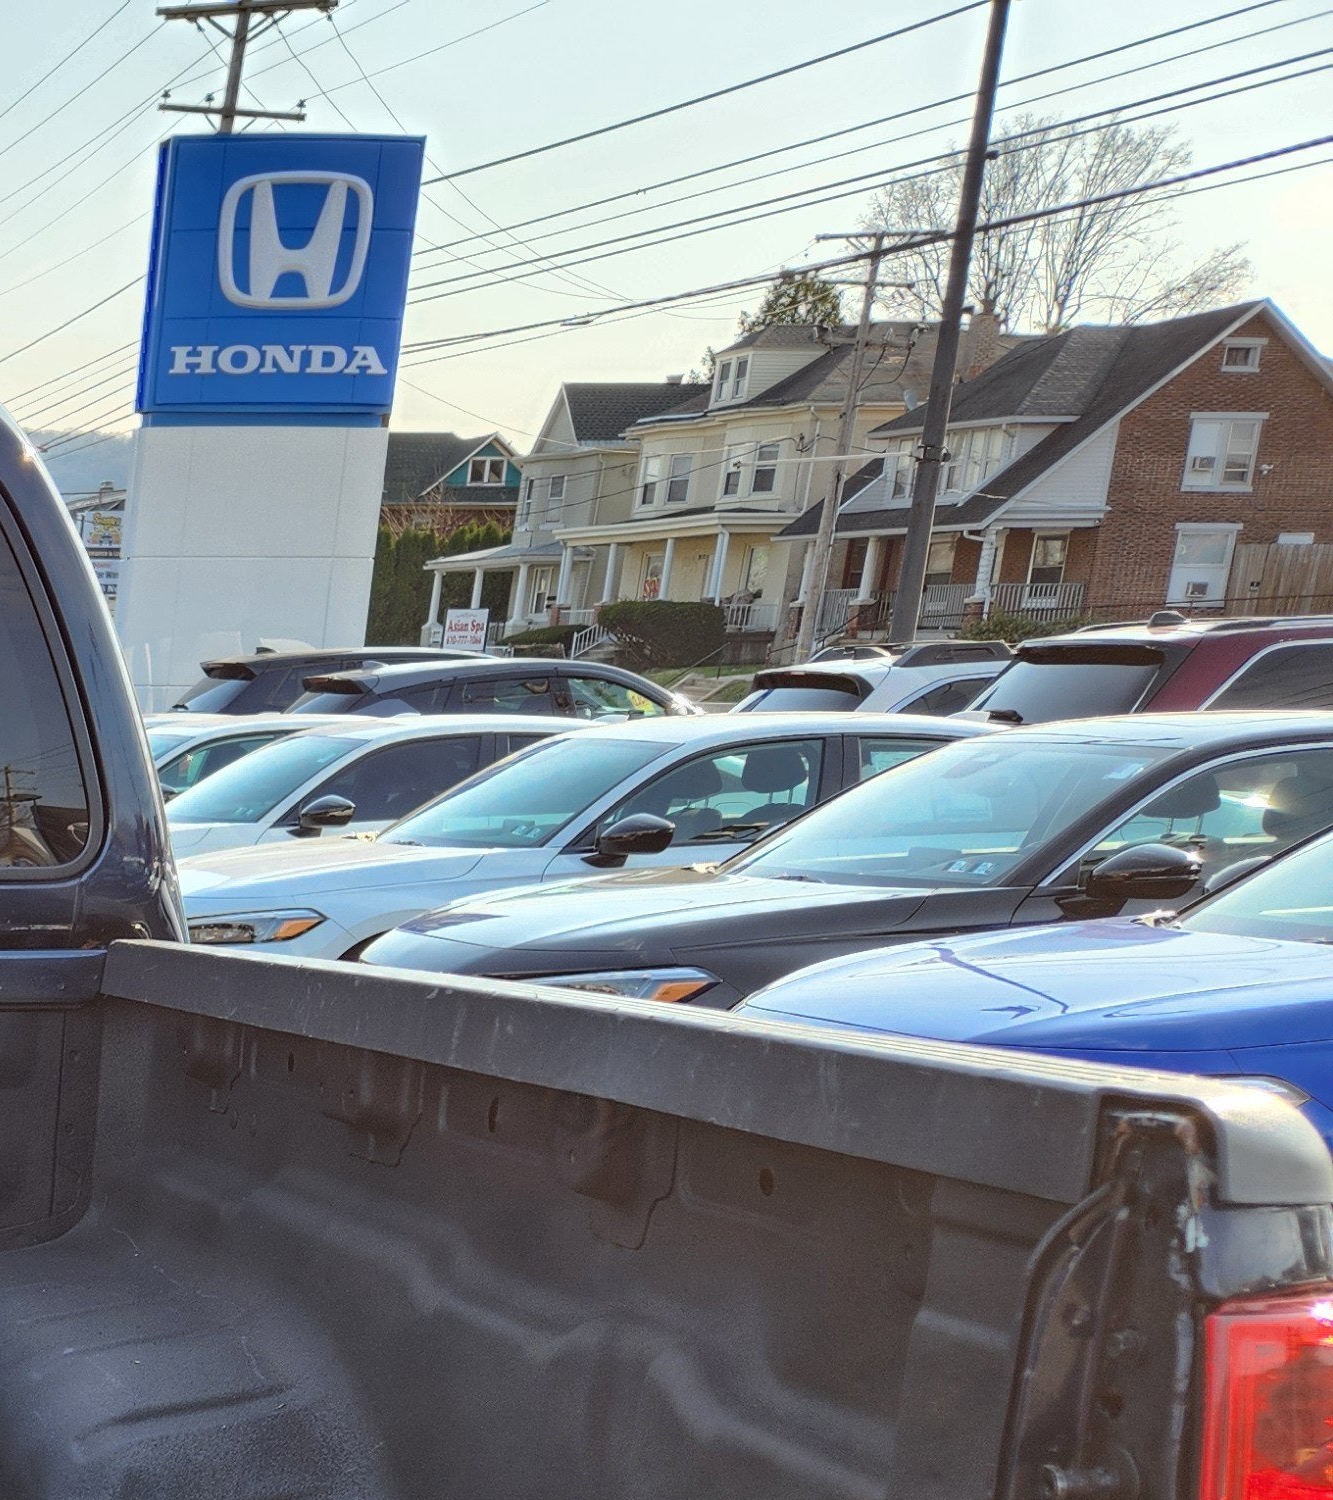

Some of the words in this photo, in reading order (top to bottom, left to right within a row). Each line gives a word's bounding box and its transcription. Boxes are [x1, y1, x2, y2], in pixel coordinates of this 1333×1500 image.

[168, 344, 388, 375] HONDA
[447, 619, 469, 632] Asian
[470, 619, 485, 634] Spa
